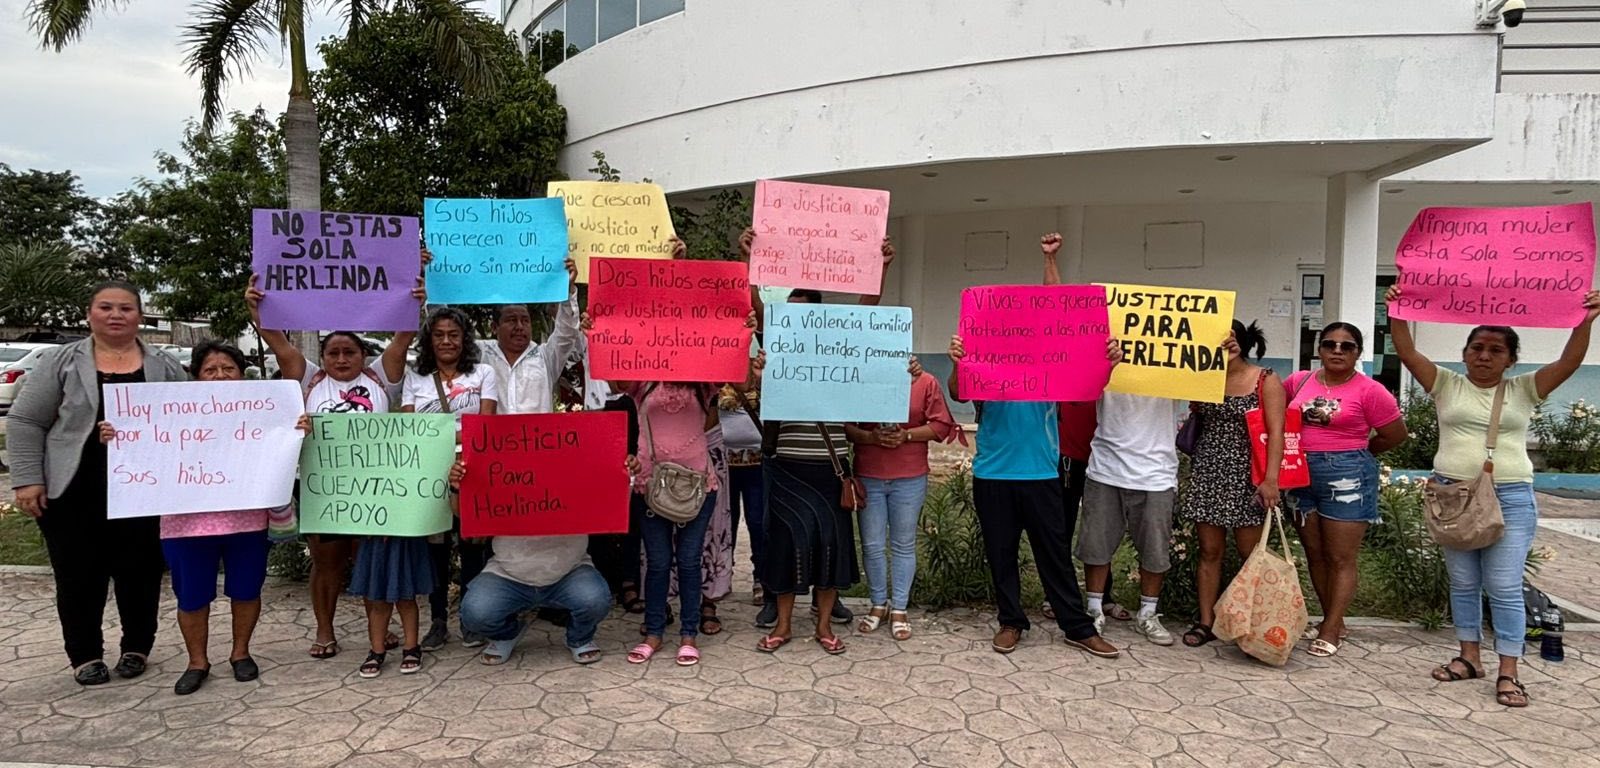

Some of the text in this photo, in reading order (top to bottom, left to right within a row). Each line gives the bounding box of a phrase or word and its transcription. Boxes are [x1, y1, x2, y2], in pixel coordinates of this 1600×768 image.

[763, 181, 781, 209] La
[864, 204, 879, 216] no
[272, 212, 403, 238] NO ESTAS
[435, 200, 533, 224] Sus hijos
[788, 223, 837, 242] negocia
[1410, 211, 1576, 242] Ninguna mujer
[281, 237, 357, 260] SOLA
[430, 232, 504, 248] merecen
[591, 243, 604, 253] no
[610, 243, 630, 254] con
[1401, 240, 1448, 261] esta
[264, 264, 389, 292] HERLINDA
[598, 260, 637, 288] Dos
[650, 263, 693, 290] hijos
[758, 263, 787, 279] para
[1397, 267, 1584, 292] muchas luchando
[592, 302, 615, 322] por
[715, 303, 739, 320] con
[1030, 295, 1056, 309] nos
[1107, 287, 1219, 314] JUSTICIA
[1397, 296, 1430, 315] por
[770, 304, 913, 333] La violencia familiar
[1043, 326, 1052, 336] a
[1057, 320, 1075, 337] las
[1124, 312, 1193, 341] PARA
[592, 328, 634, 345] miedo
[712, 335, 740, 355] para
[770, 332, 805, 354] deja
[815, 333, 861, 359] heridas
[960, 347, 1068, 371] eduquemos con
[1116, 339, 1225, 373] ERLINDA
[115, 386, 276, 424] Hoy marchamos
[114, 421, 263, 451] por la paz de
[309, 415, 440, 441] TE APOYAMOS
[471, 423, 580, 453] Justicia
[318, 442, 421, 469] HERLINDA
[307, 473, 408, 498] CUENTAS
[489, 461, 534, 487] Para
[319, 501, 388, 526] APOYO
